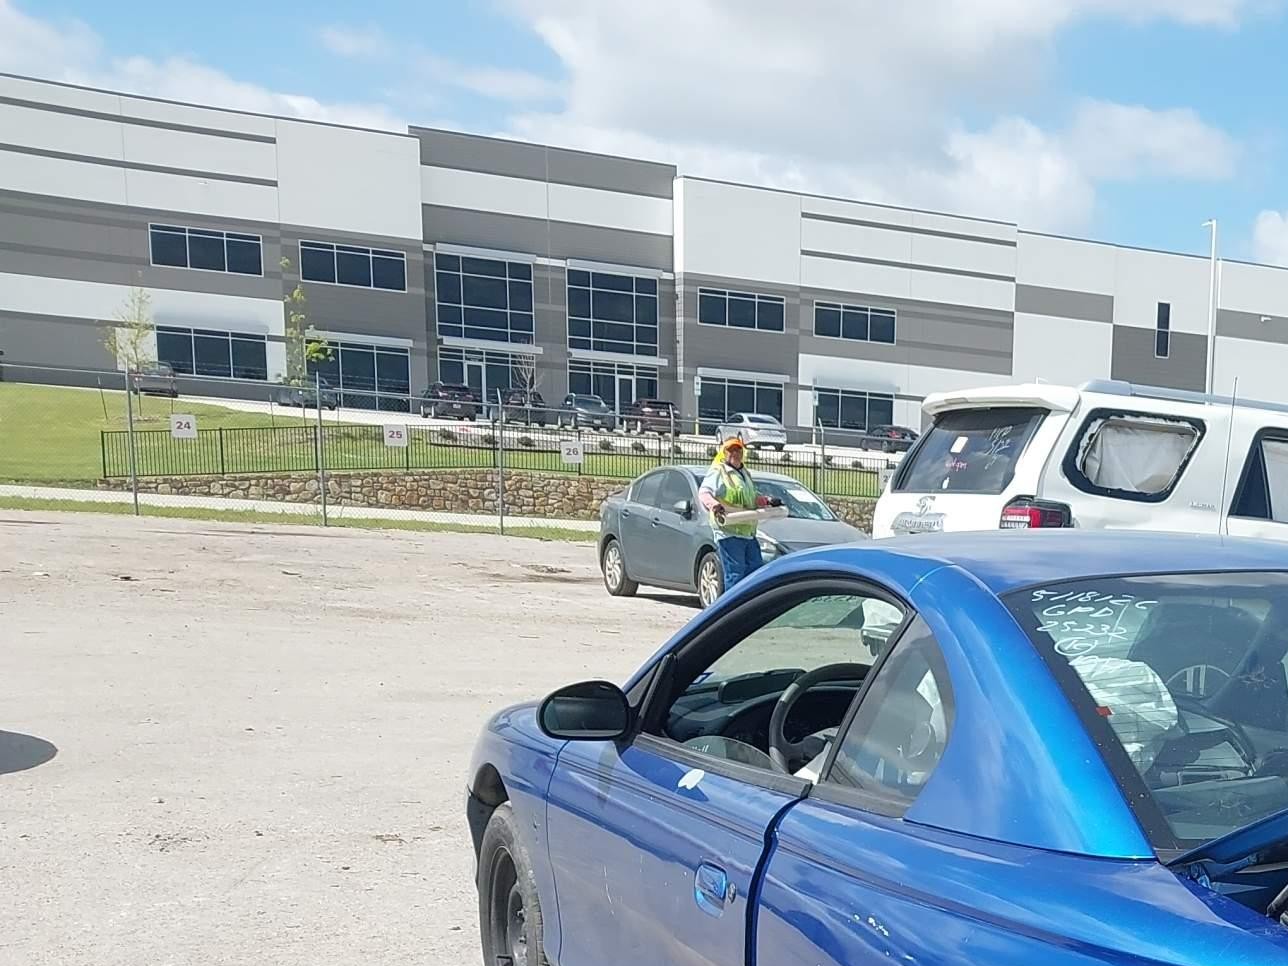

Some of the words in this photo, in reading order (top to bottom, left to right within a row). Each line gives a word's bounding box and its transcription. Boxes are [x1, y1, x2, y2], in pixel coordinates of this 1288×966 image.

[175, 421, 192, 430] 24
[388, 430, 403, 439] 25
[565, 447, 579, 456] 26
